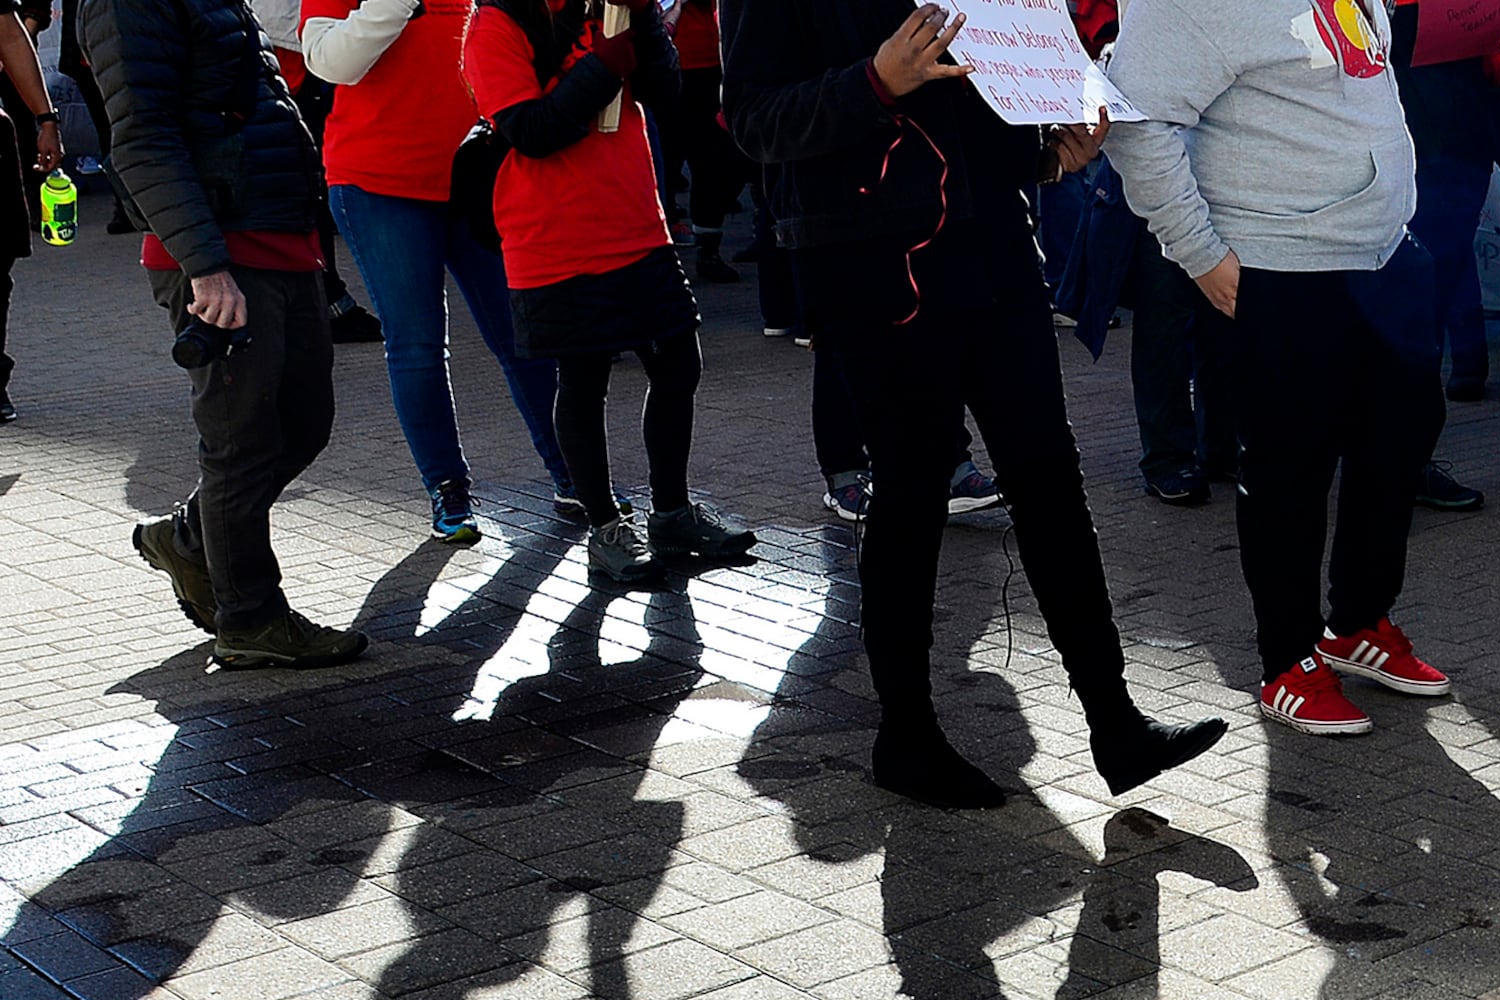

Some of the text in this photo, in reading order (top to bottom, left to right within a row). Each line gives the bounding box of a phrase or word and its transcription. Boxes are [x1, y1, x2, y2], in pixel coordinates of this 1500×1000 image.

[1012, 22, 1065, 62] belongs
[1061, 28, 1080, 54] to
[1019, 62, 1045, 79] who
[988, 84, 1017, 112] for
